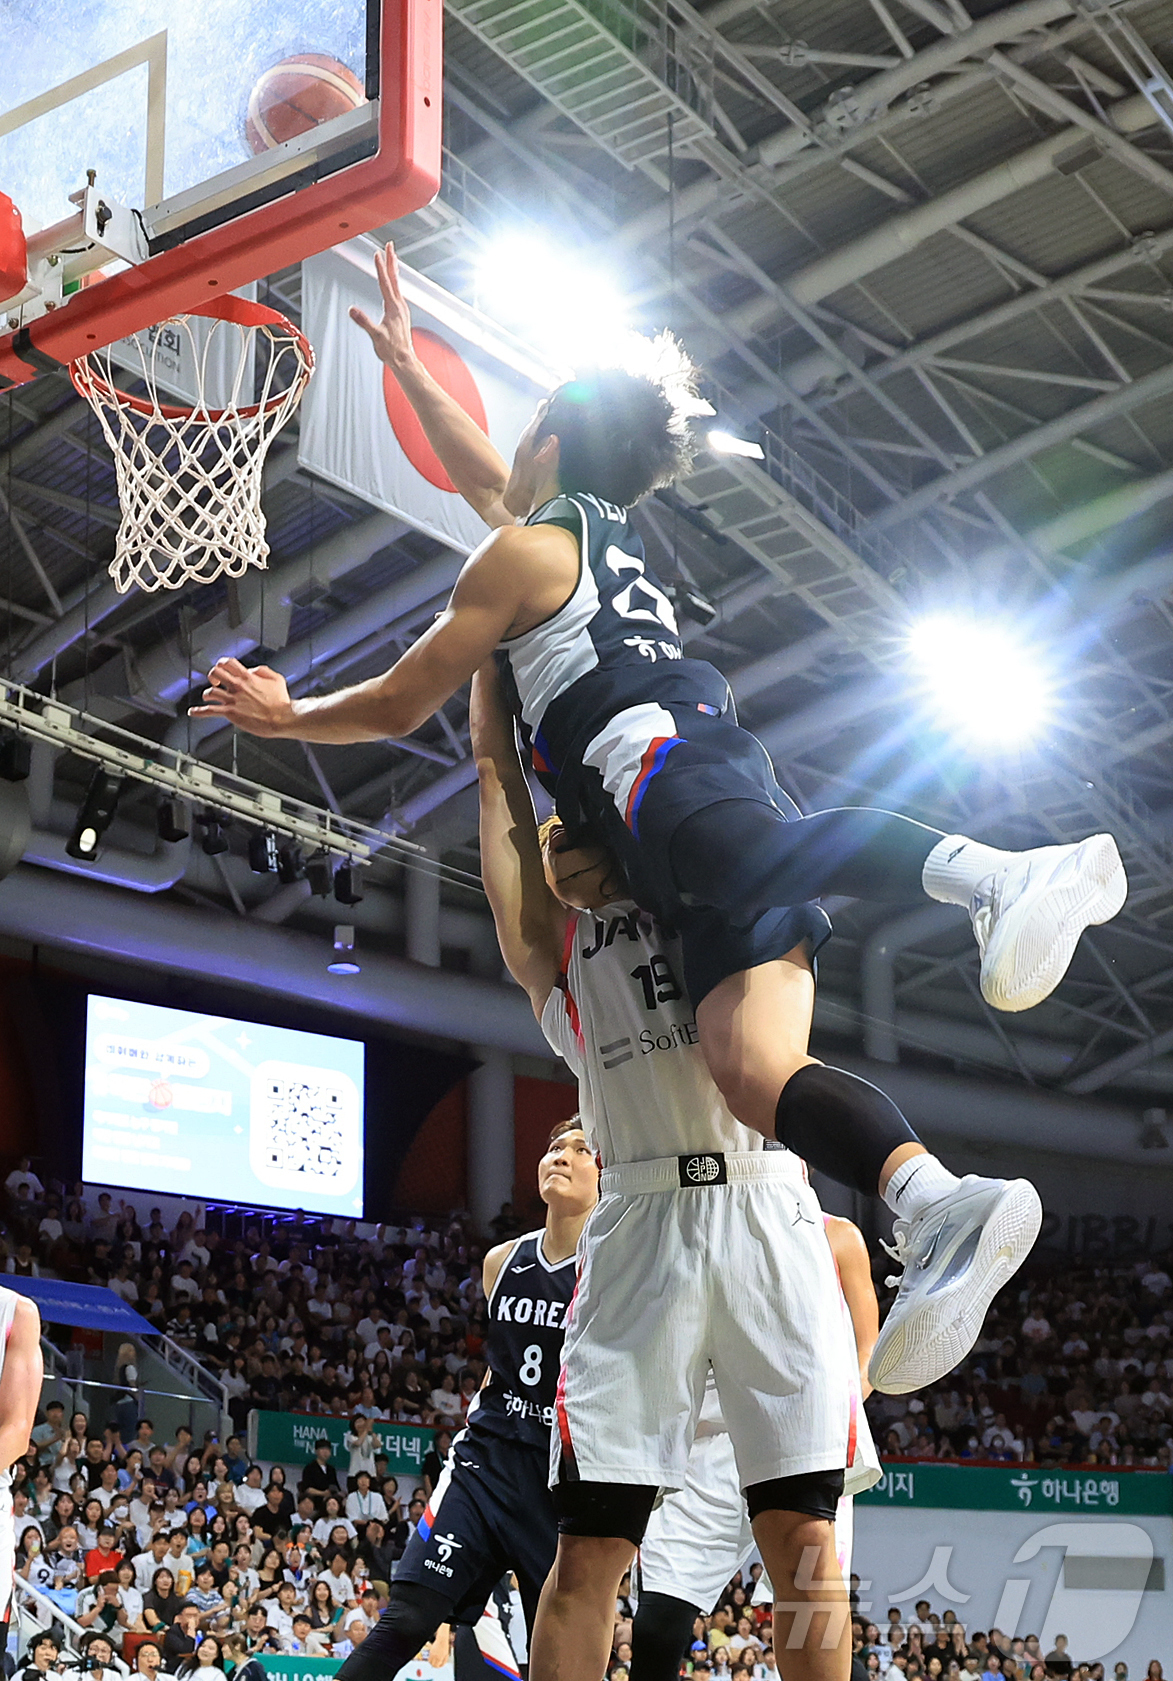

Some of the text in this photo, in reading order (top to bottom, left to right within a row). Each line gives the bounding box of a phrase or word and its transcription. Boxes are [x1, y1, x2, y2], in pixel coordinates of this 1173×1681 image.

[630, 955, 683, 1010] 19
[519, 1344, 543, 1386] 8
[293, 1425, 329, 1441] HANA
[304, 1440, 340, 1457] NT
[1042, 1478, 1120, 1506] 하나은행
[37, 1568, 50, 1584] 9
